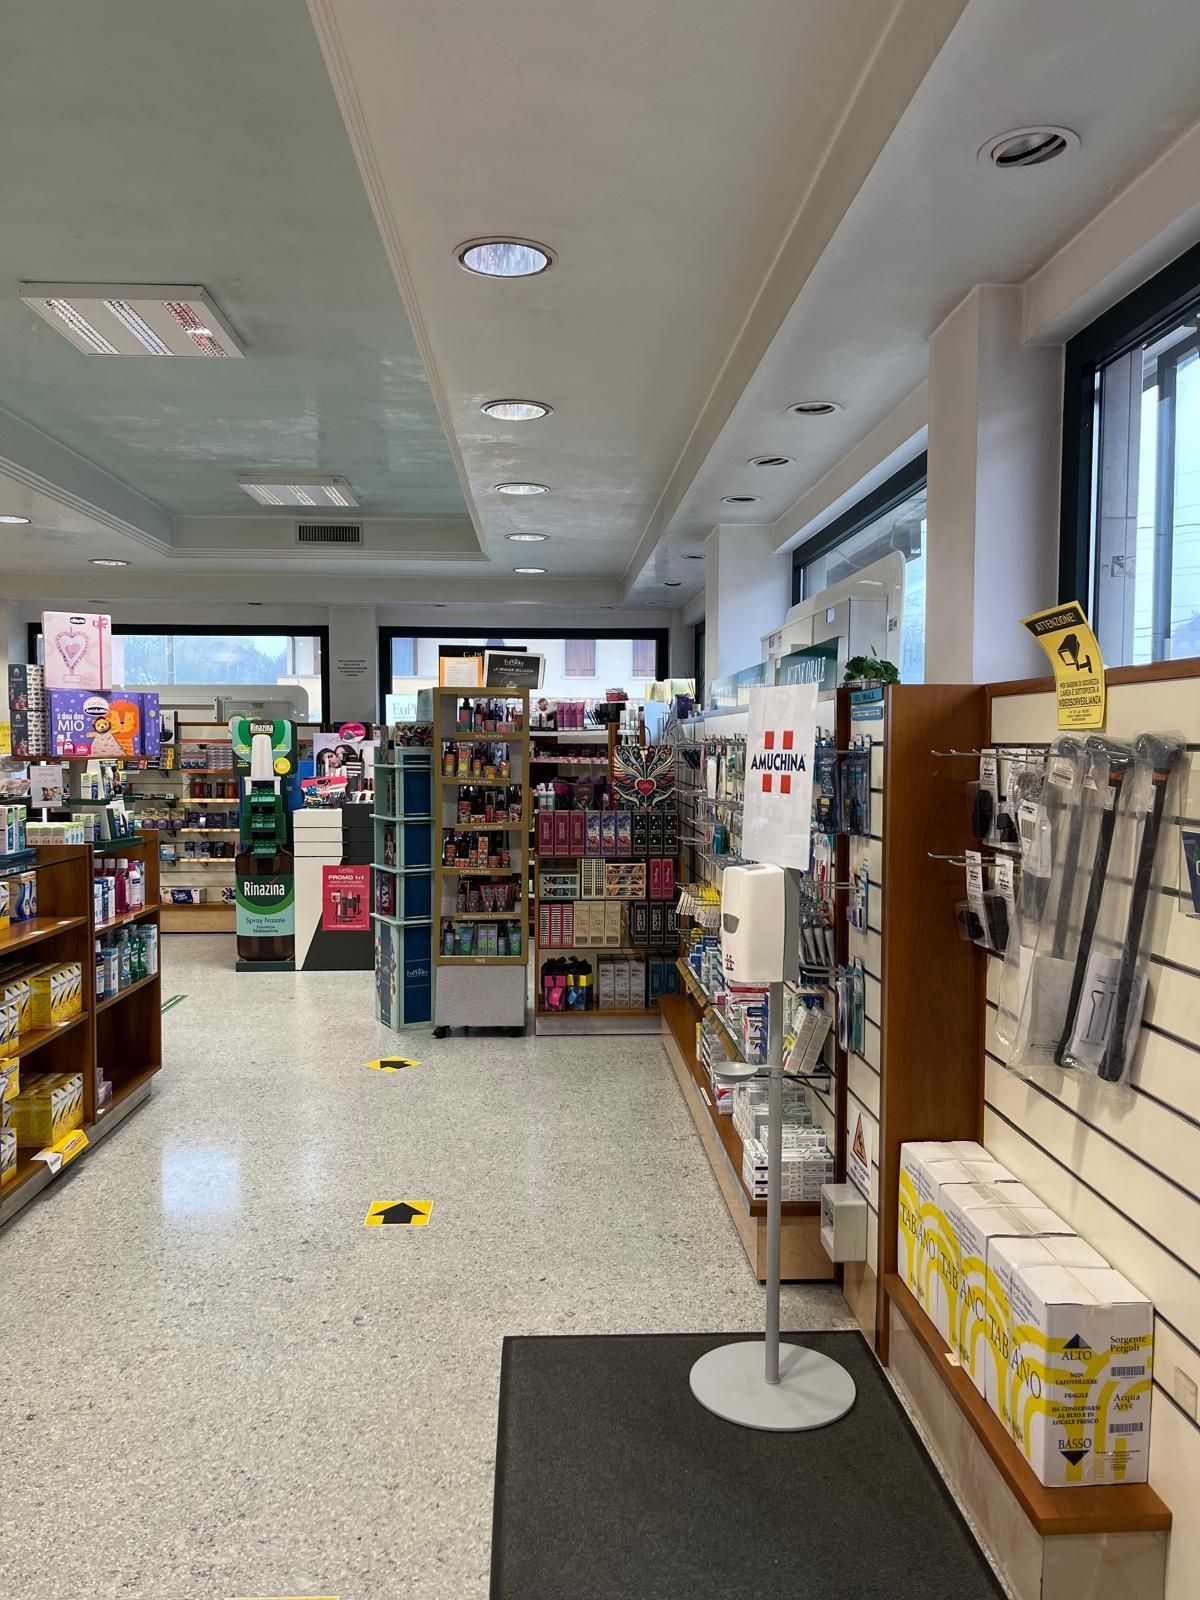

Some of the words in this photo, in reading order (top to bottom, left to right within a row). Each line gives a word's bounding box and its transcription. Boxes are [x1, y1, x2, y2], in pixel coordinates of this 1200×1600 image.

[1036, 613, 1075, 631] ATTENZIONE
[805, 656, 826, 683] ORALE
[1058, 696, 1102, 707] VIDEOSORVEGLIANZA
[57, 719, 85, 732] MIO
[750, 753, 807, 772] AMUCHINA
[243, 881, 285, 897] Rinazina
[245, 917, 263, 926] Spray
[264, 916, 286, 924] Nasale
[1110, 1336, 1147, 1346] Sorgente
[1110, 1344, 1140, 1354] Pergoli
[1061, 1350, 1093, 1361] ALTO
[1113, 1393, 1141, 1404] Acqua
[1057, 1438, 1092, 1450] BASSO
